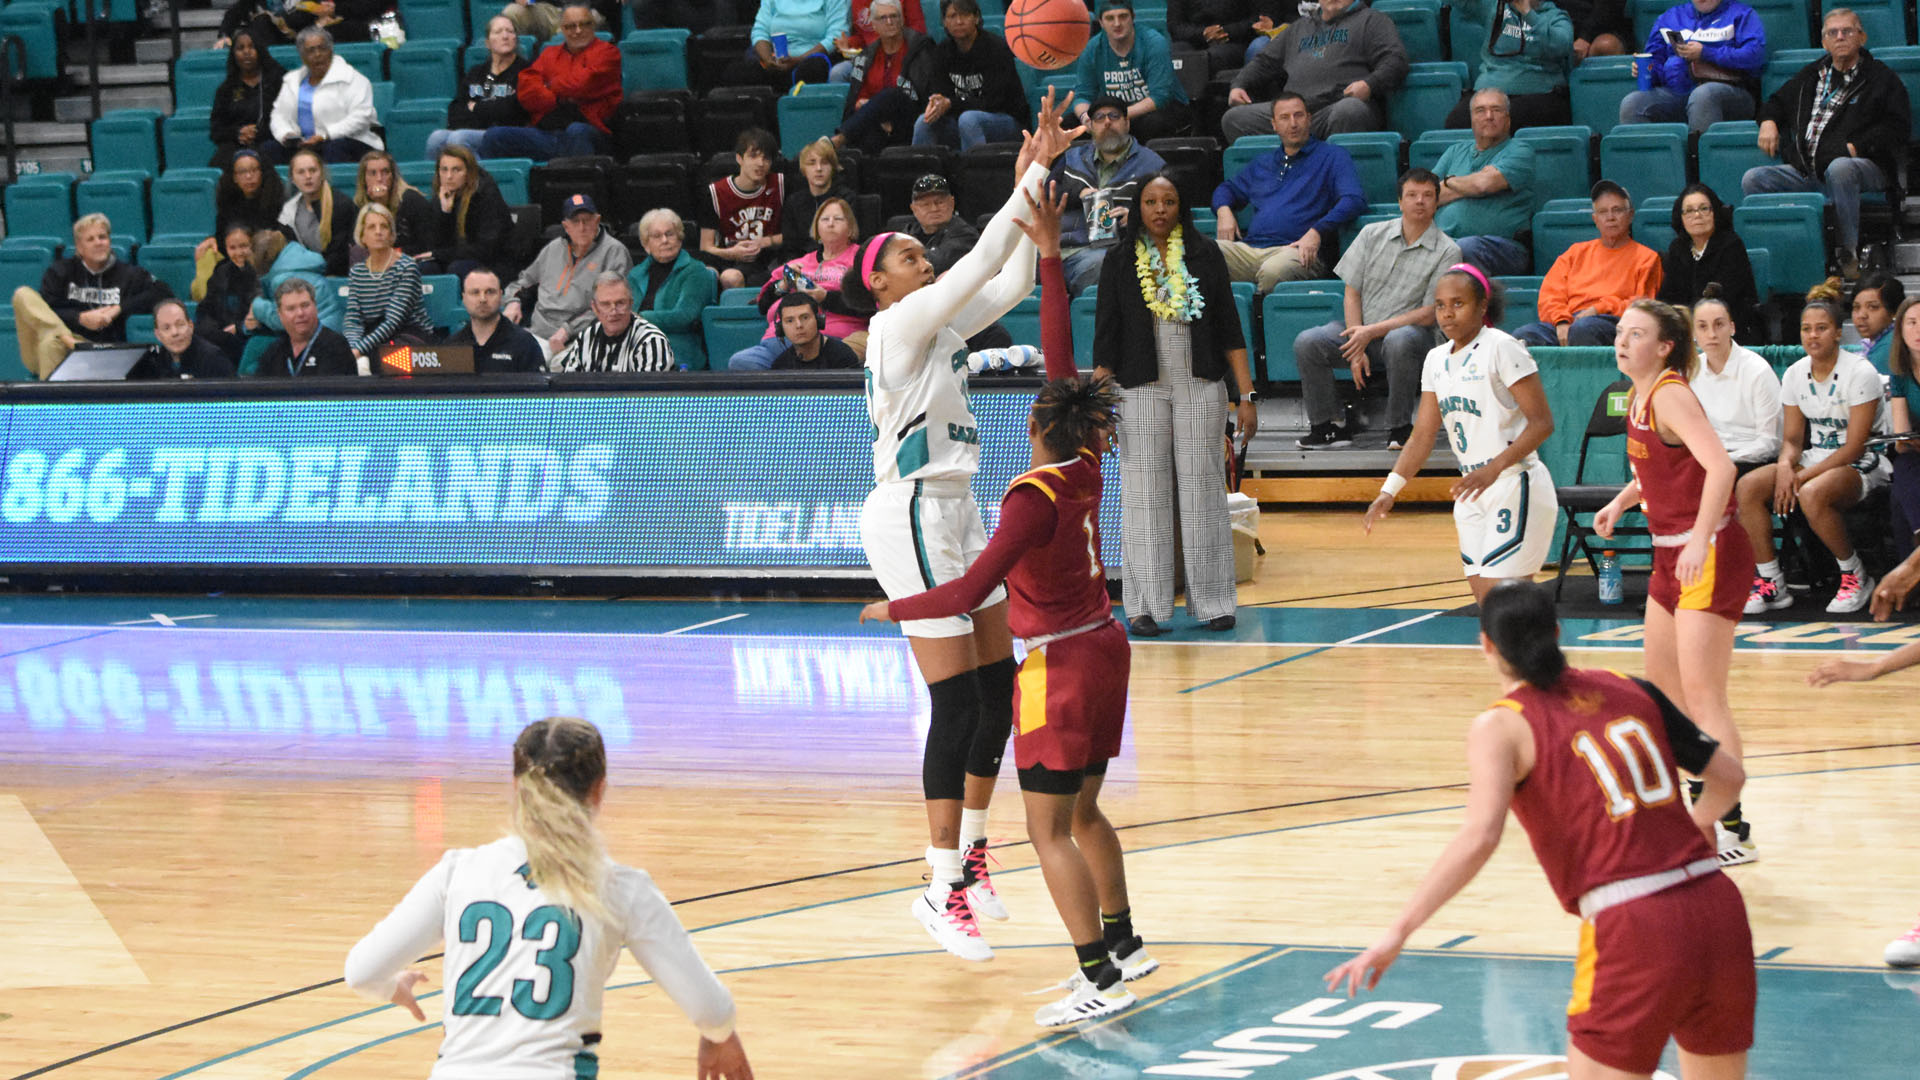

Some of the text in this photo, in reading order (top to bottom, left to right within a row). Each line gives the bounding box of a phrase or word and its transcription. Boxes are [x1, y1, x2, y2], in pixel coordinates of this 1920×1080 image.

[729, 206, 774, 227] LOWER
[411, 352, 441, 368] POSS.
[1454, 421, 1468, 454] 3
[722, 500, 864, 549] TIDELAN
[1496, 508, 1512, 534] 3
[1083, 509, 1102, 578] 1
[1571, 715, 1678, 823] 10
[452, 900, 583, 1021] 23
